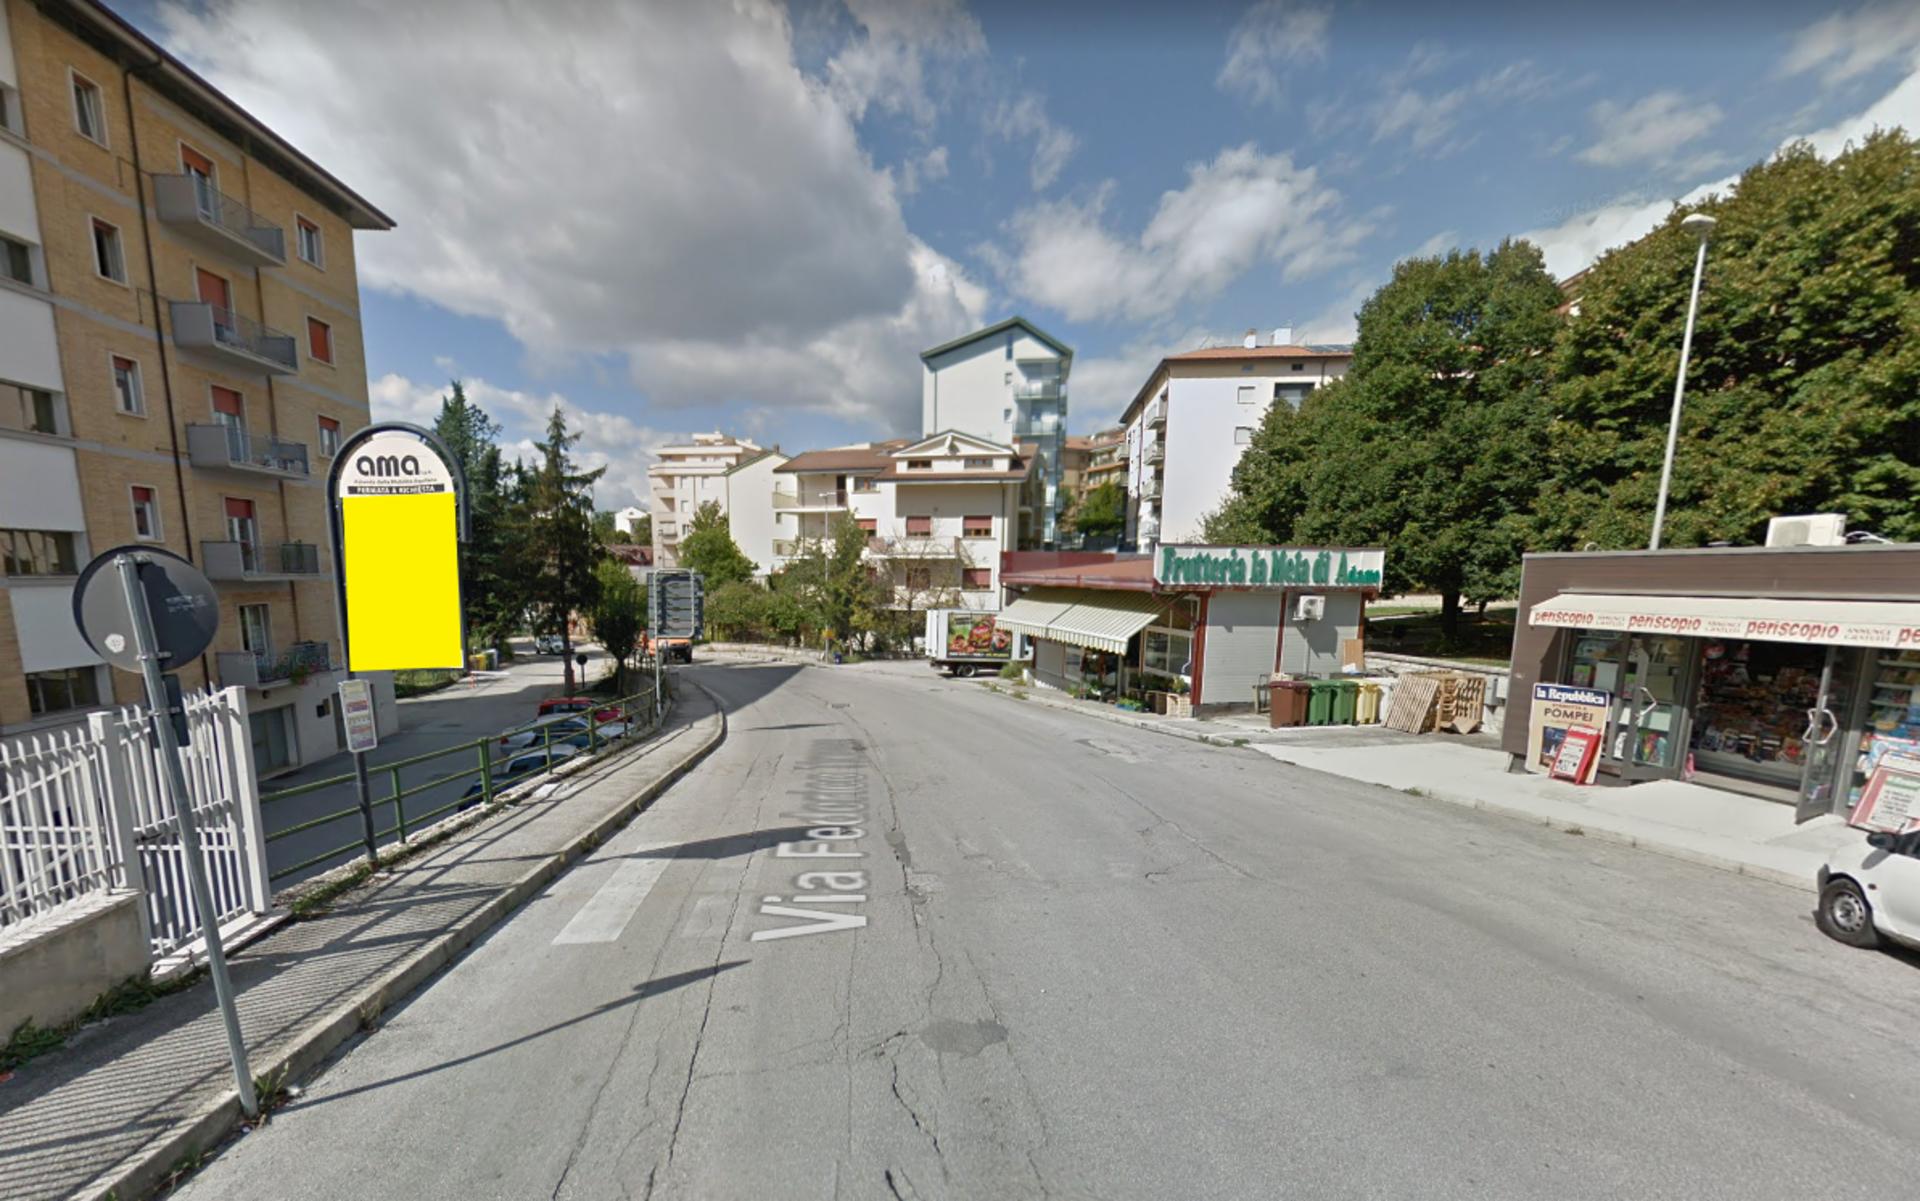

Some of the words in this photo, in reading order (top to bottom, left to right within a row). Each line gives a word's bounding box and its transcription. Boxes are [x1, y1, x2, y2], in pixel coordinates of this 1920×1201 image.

[356, 455, 420, 477] ama
[1162, 547, 1247, 584] Frutteria
[1248, 550, 1268, 583] la
[1270, 550, 1310, 583] Mela
[1312, 551, 1331, 583] di
[1535, 611, 1594, 628] periscopio
[1627, 615, 1702, 634] periscopio
[1745, 620, 1839, 641] periscopio
[1536, 687, 1546, 698] la
[1548, 688, 1605, 704] Repubblica
[1544, 708, 1594, 722] POMPEI
